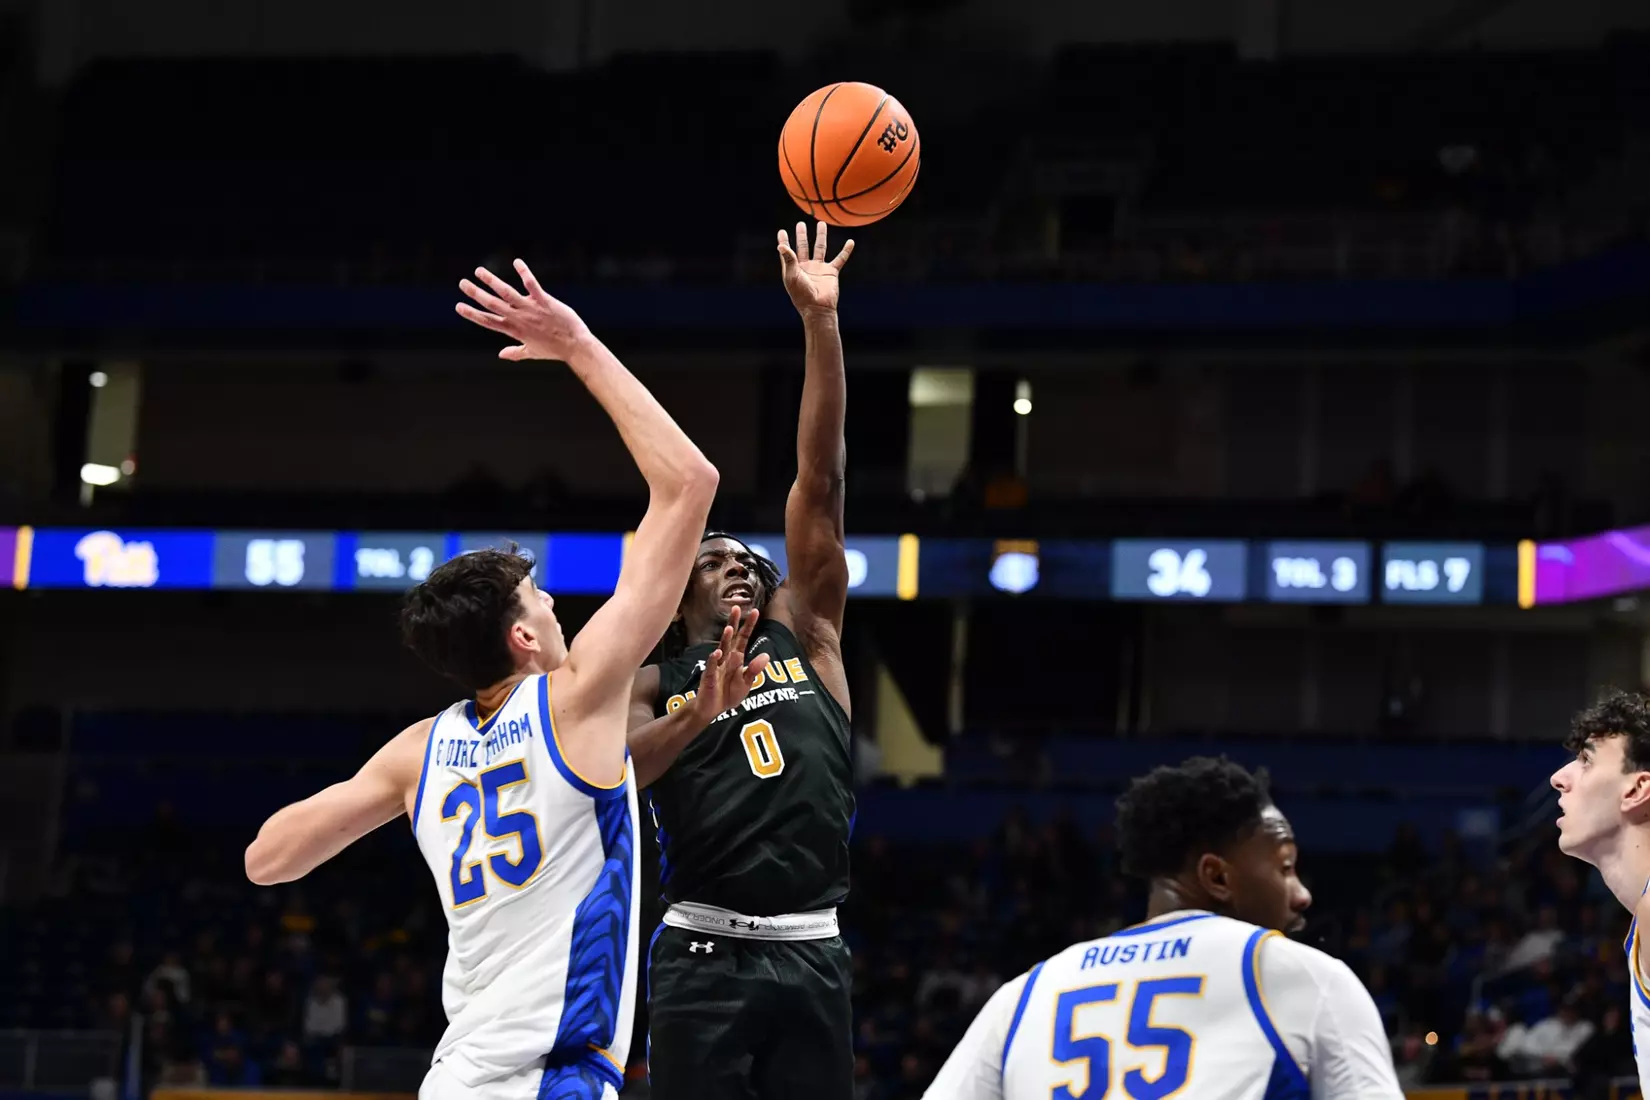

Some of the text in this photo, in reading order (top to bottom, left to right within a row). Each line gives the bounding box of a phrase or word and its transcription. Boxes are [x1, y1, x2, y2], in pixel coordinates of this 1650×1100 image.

[877, 117, 909, 154] Pitt
[244, 538, 306, 586] 55
[408, 546, 434, 580] 2
[1147, 548, 1212, 597] 34
[1331, 557, 1357, 592] 3
[1443, 557, 1471, 592] 7
[741, 688, 799, 712] WAYNE
[446, 739, 480, 768] DIAZ
[740, 719, 785, 779] 0
[439, 758, 545, 910] 25
[1080, 936, 1192, 971] AUSTIN
[1050, 974, 1208, 1100] 55
